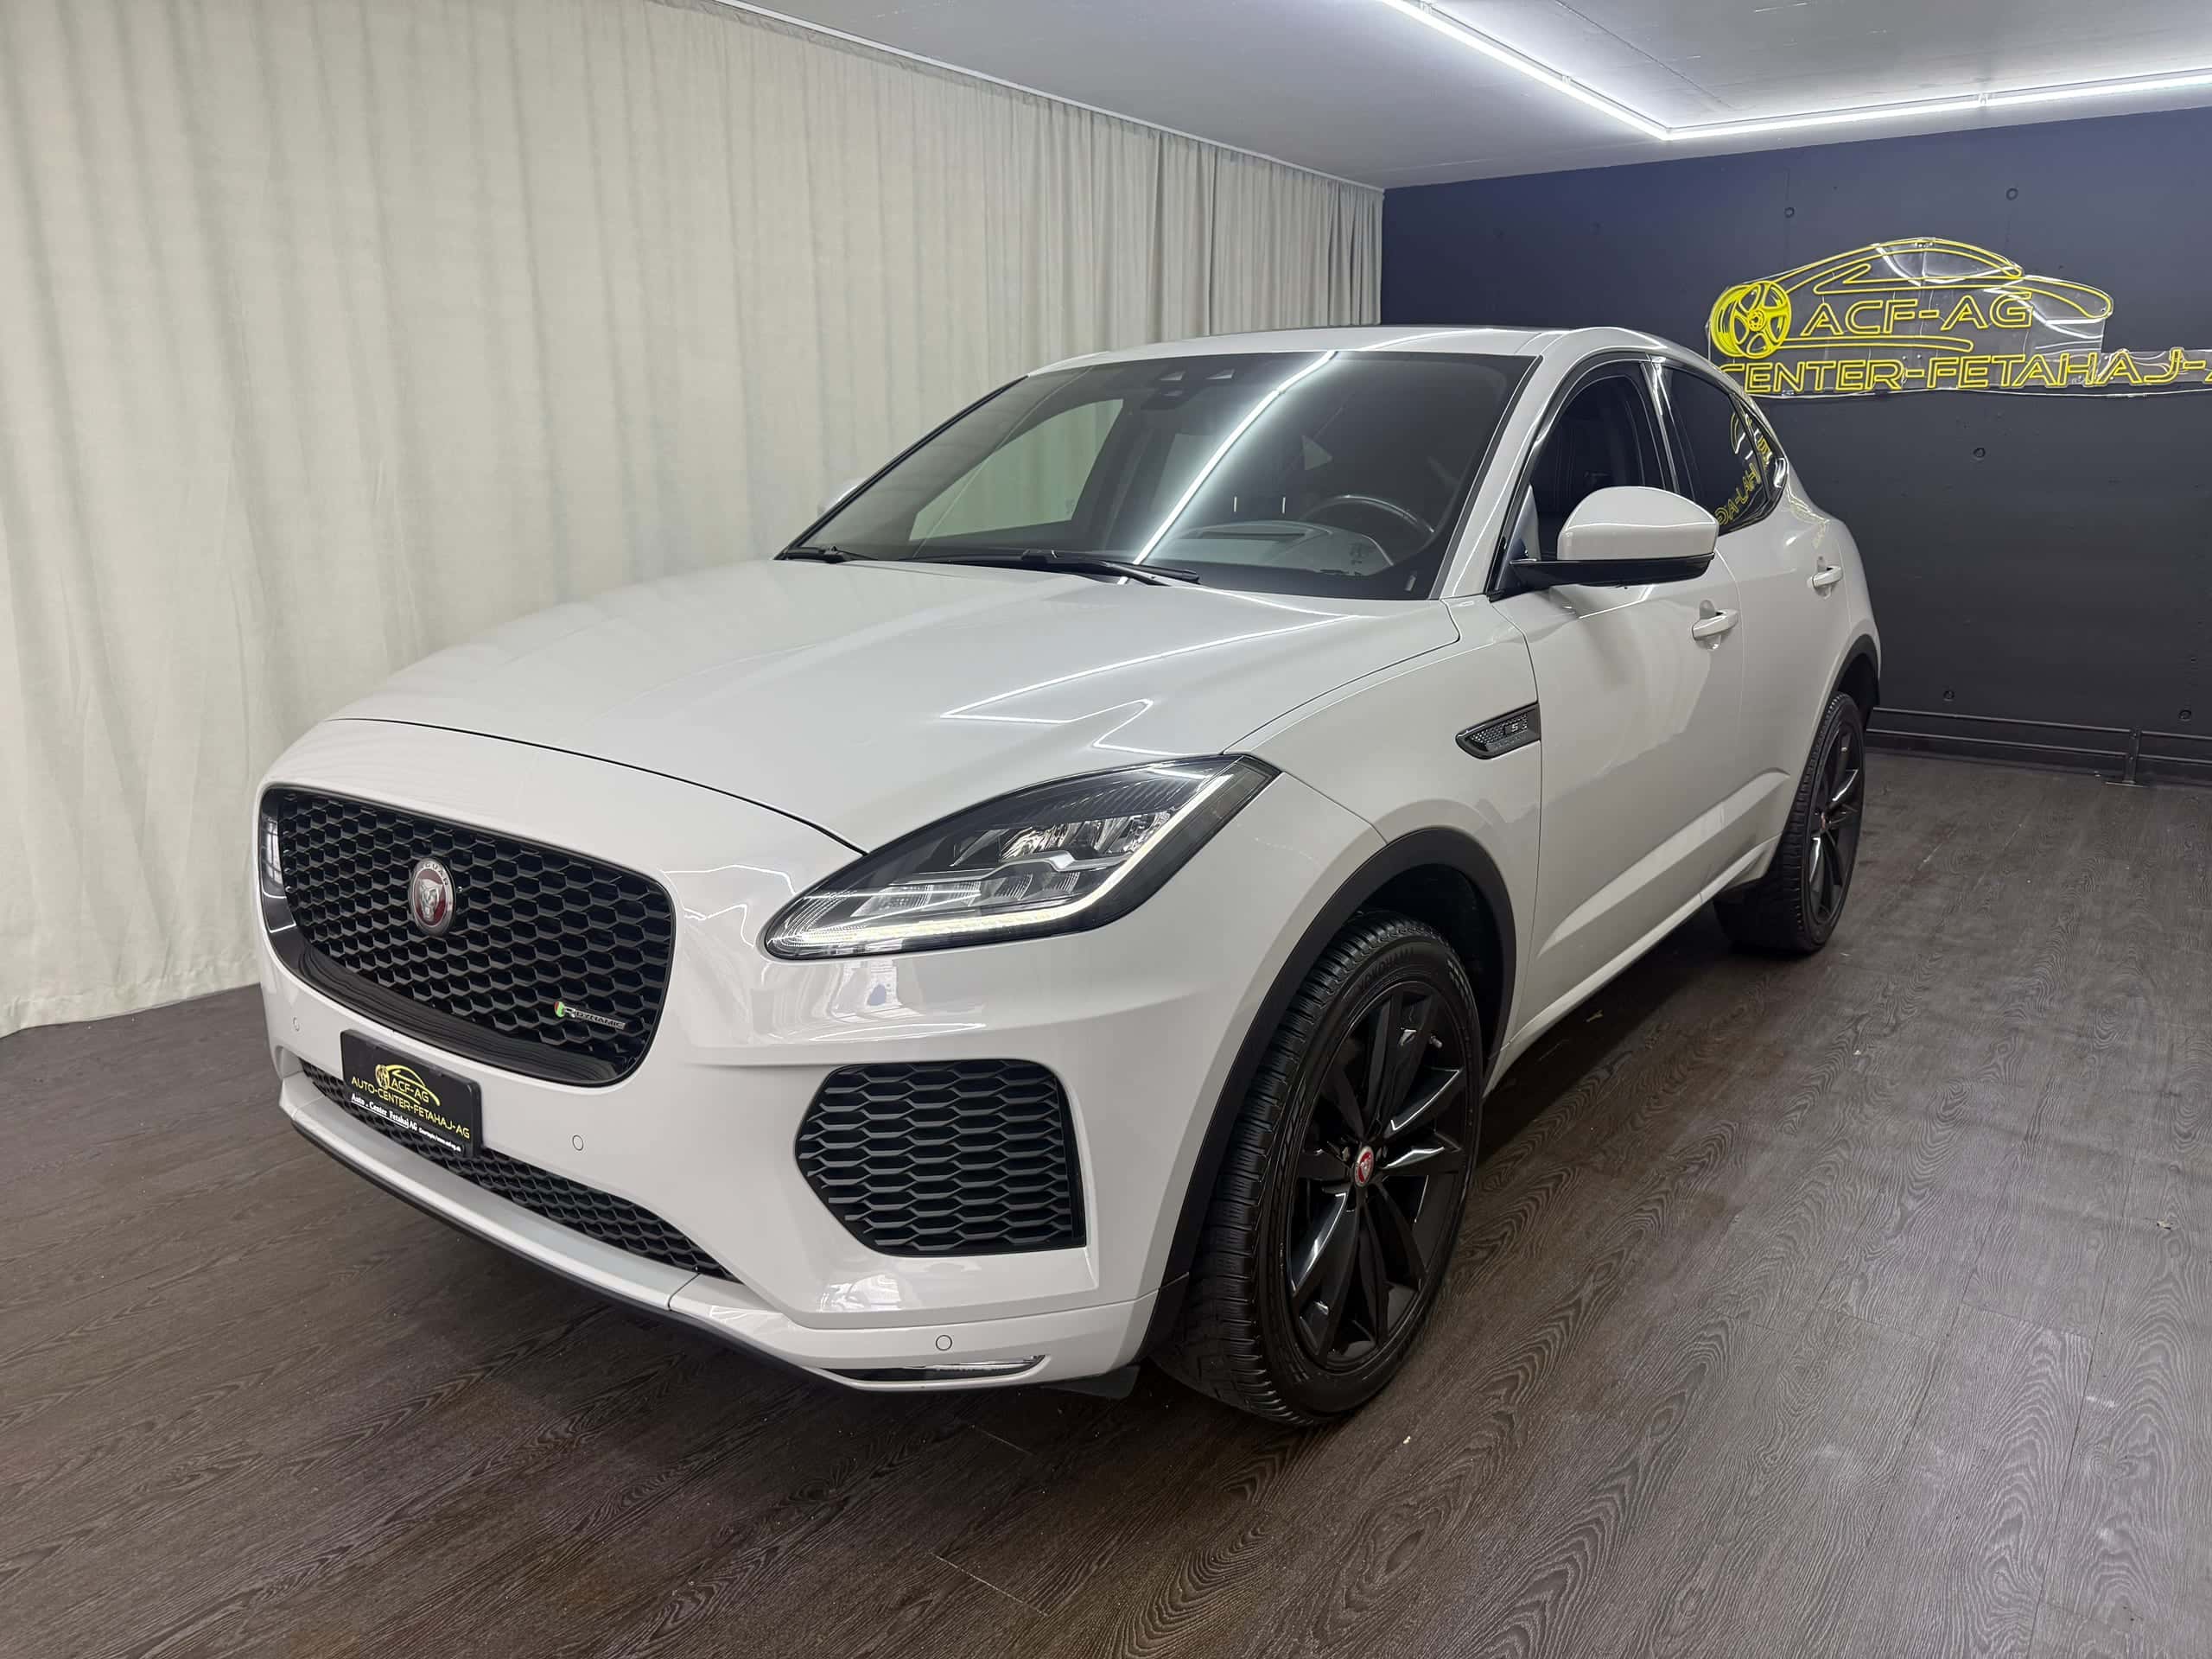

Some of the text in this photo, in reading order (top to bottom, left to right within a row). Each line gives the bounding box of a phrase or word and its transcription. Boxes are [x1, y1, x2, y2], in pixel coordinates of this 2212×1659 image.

[1800, 290, 2035, 338] ACF-AG
[1719, 347, 2212, 393] ENTER-FETAHAJ-
[351, 1076, 471, 1140] AUTO-CENTER-FETAHAJ-AG
[391, 1077, 429, 1103] ACF-AG
